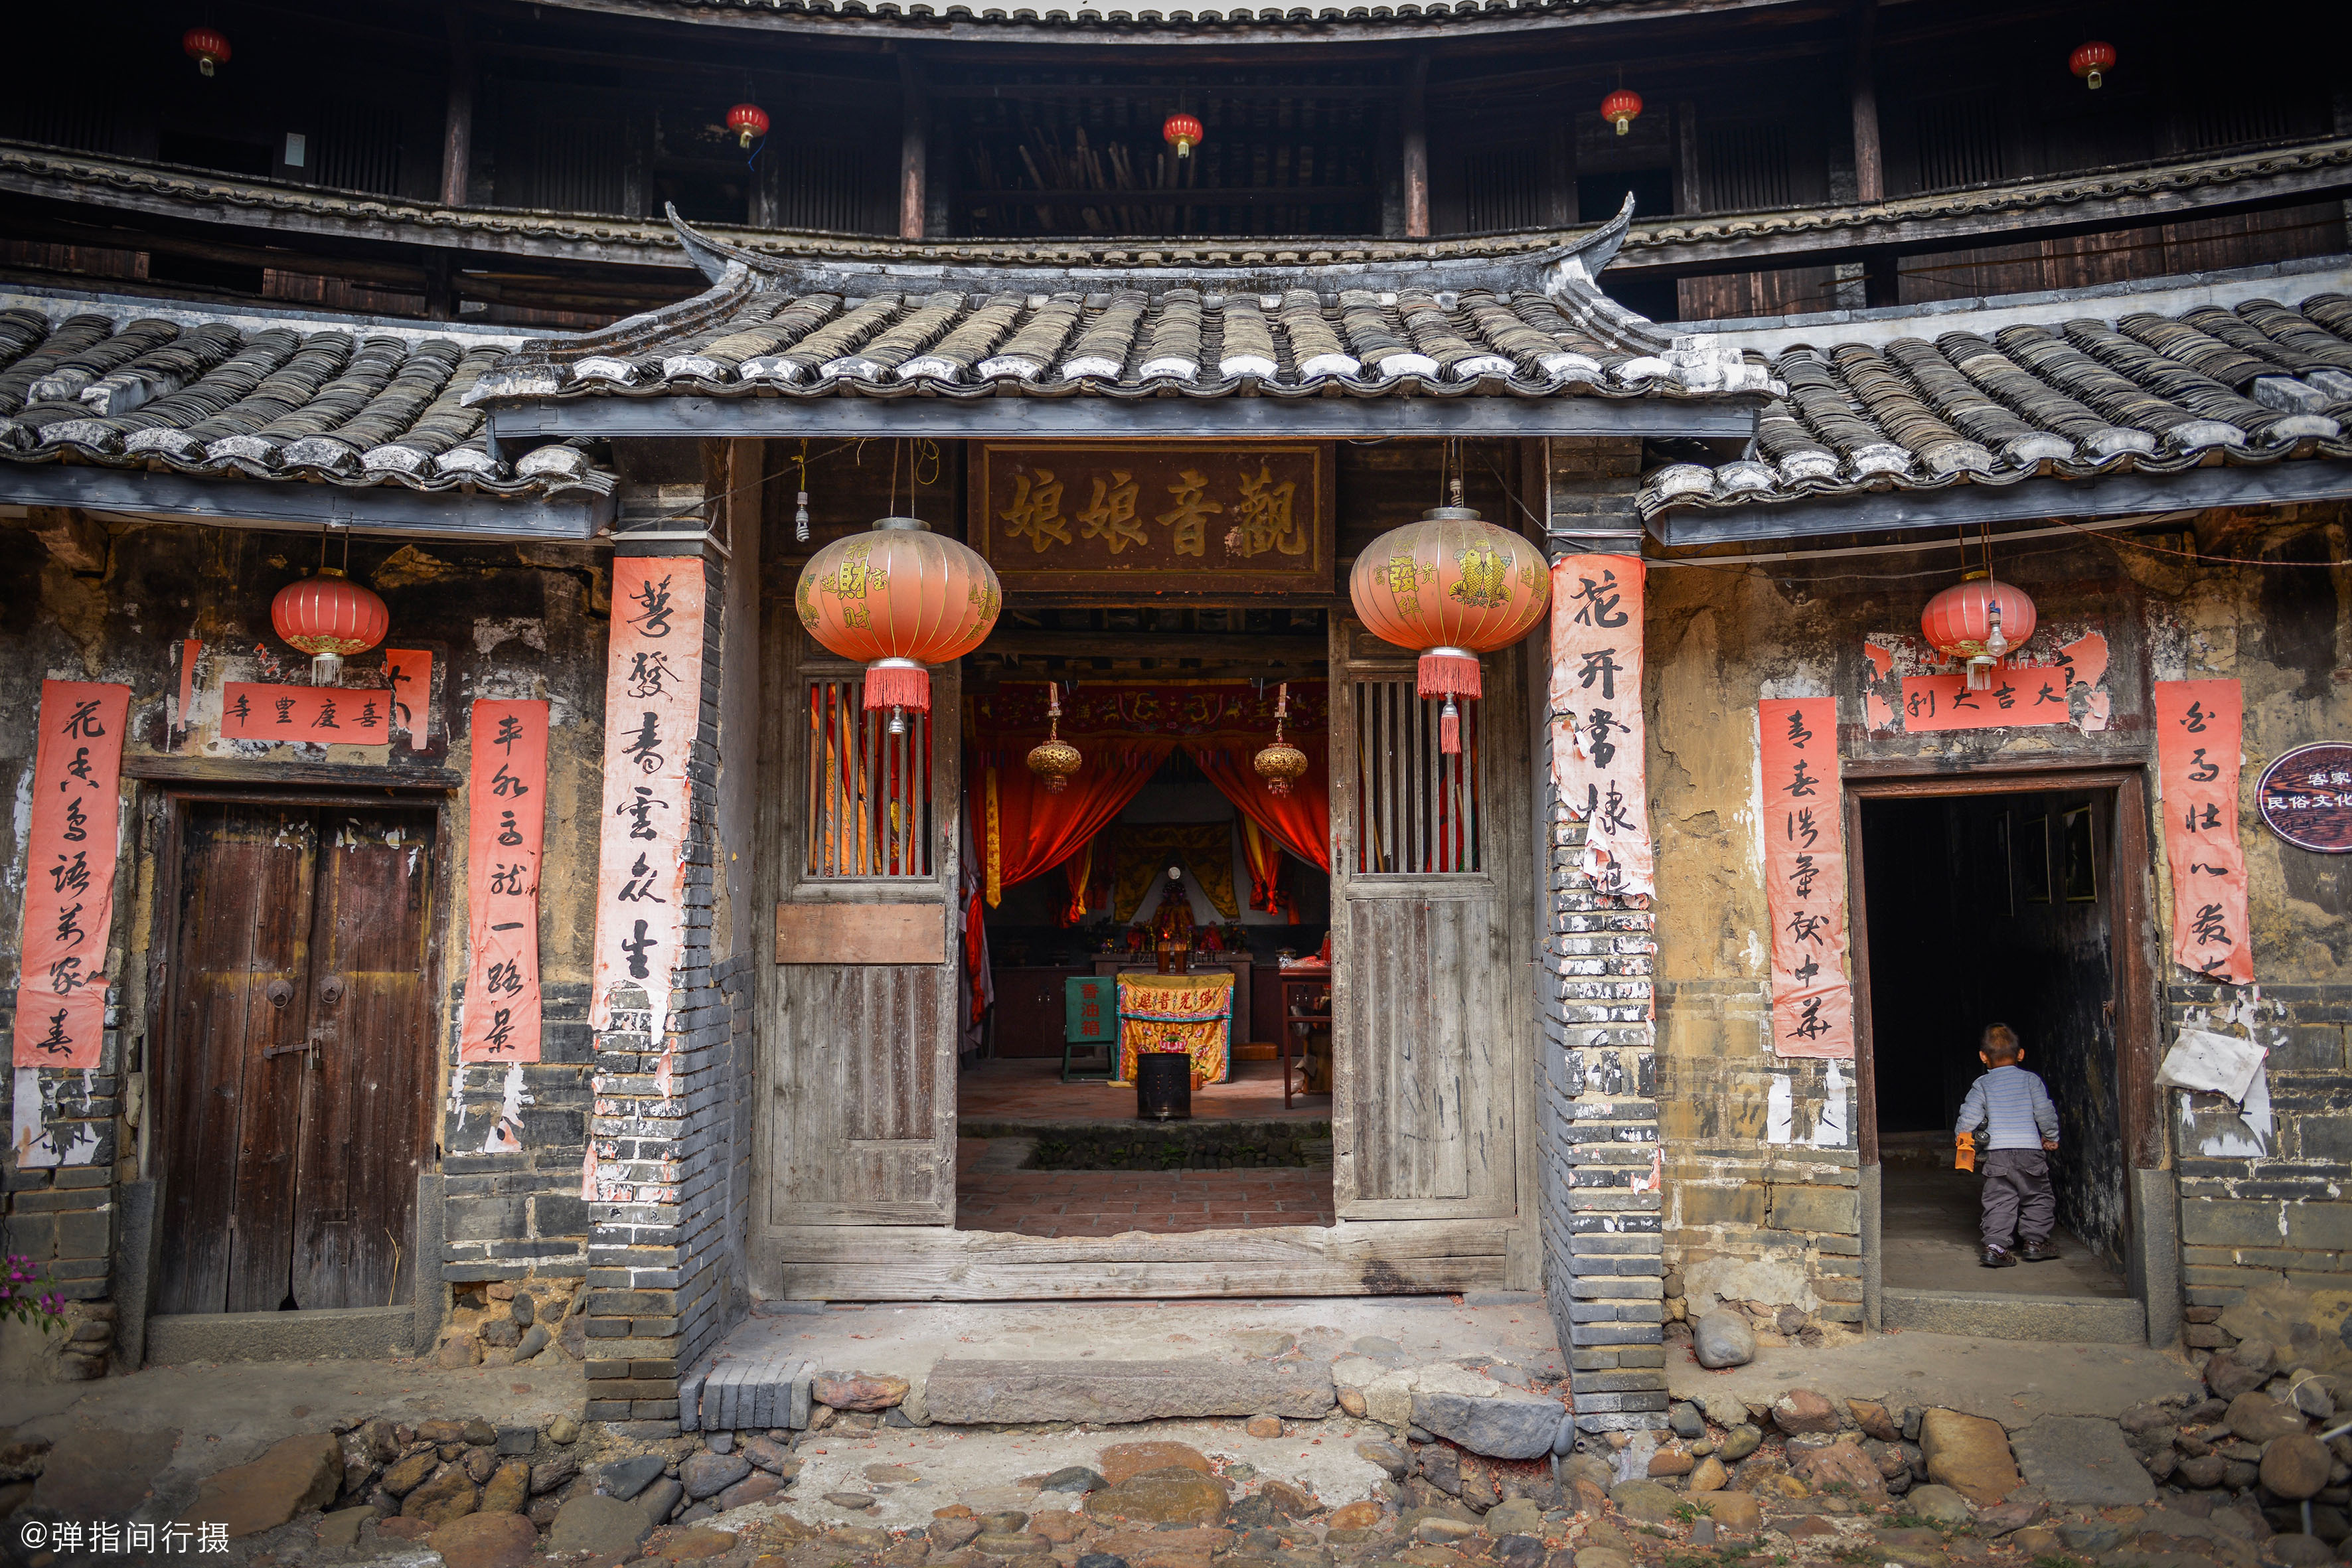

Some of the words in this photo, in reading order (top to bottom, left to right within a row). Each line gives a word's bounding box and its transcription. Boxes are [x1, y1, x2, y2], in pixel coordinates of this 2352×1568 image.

[1907, 681, 2063, 718] 大吉大利
[2307, 772, 2351, 786] 客家
[2268, 793, 2352, 810] 民俗文化
[1080, 983, 1100, 1037] 香油箱
